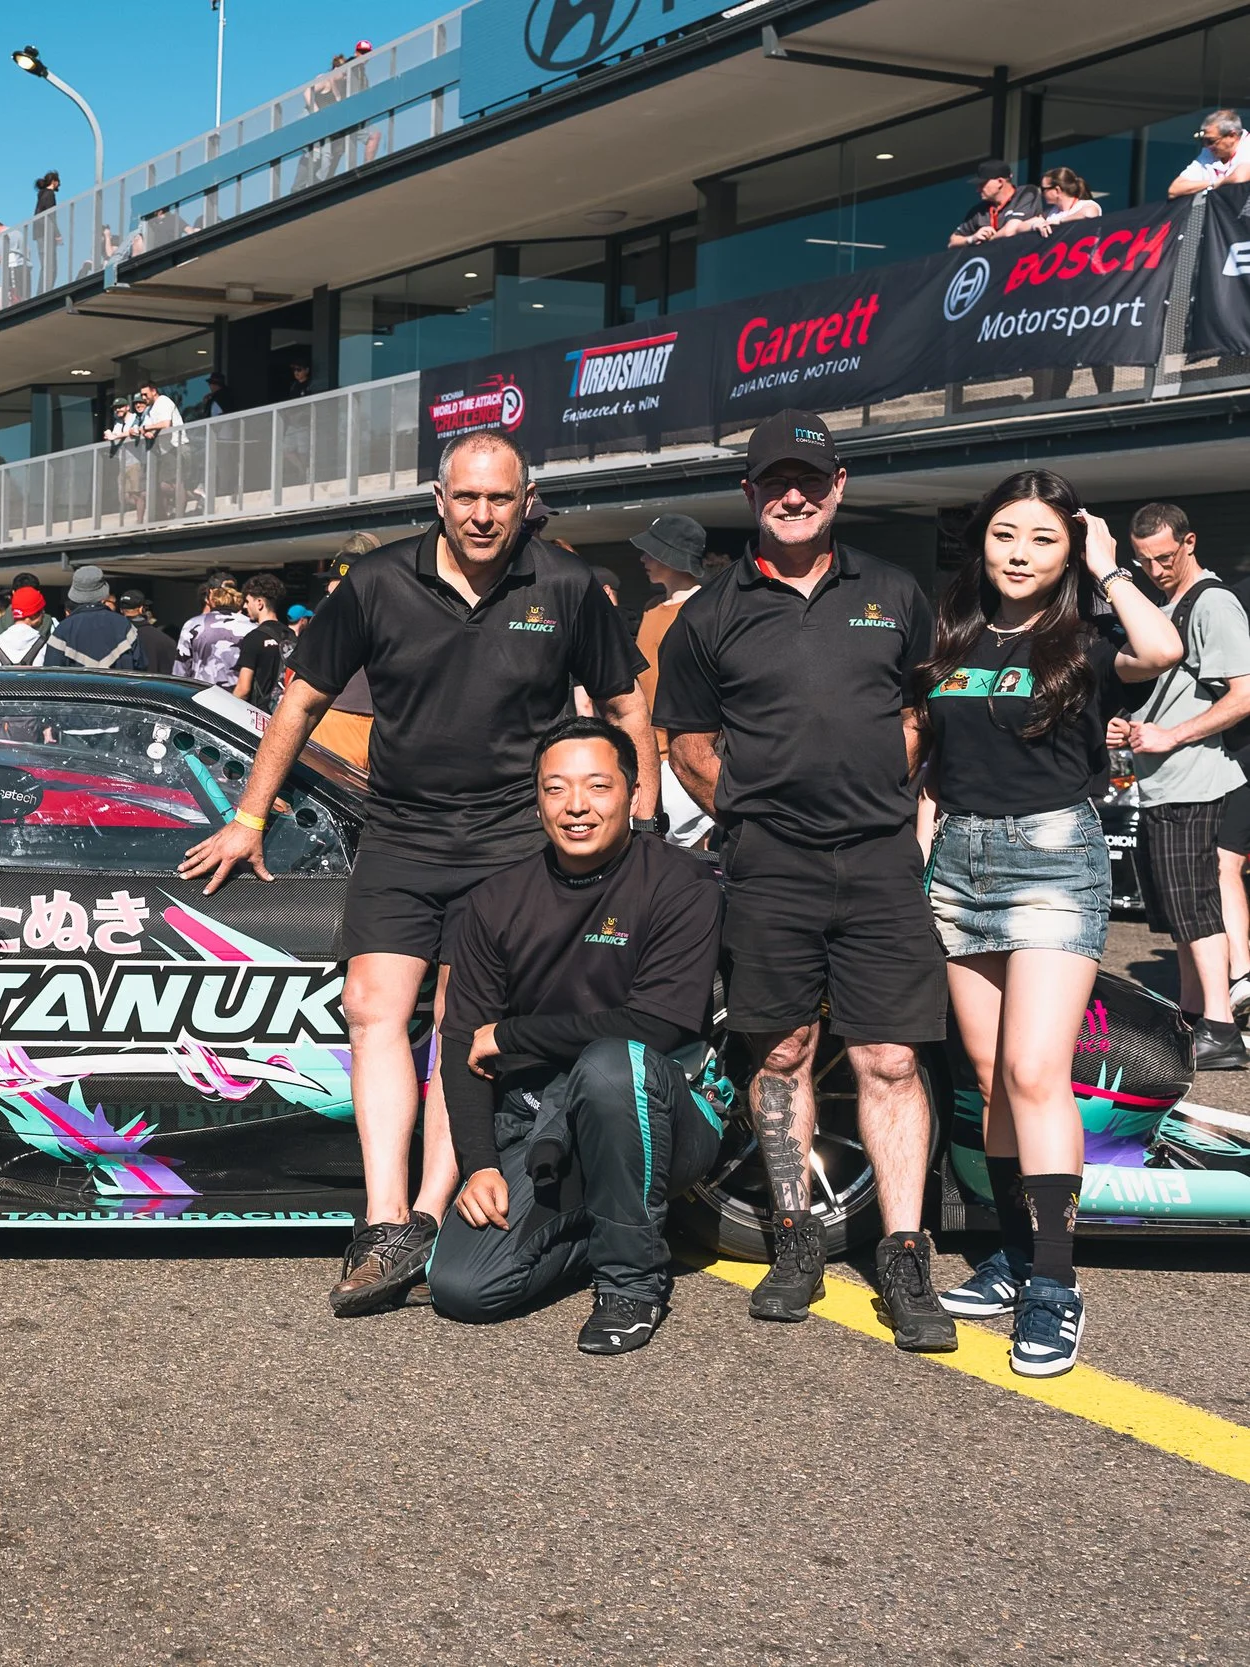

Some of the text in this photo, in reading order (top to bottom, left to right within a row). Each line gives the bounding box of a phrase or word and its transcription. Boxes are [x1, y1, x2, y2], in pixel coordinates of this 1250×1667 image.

[1004, 221, 1171, 294] BOSCH
[736, 294, 880, 373] Garrett
[977, 296, 1145, 343] Motorsport
[565, 331, 678, 397] TURBOSMART
[730, 356, 861, 399] ADVANCING MOTION
[433, 392, 503, 418] WORLD TIME ATTACK
[562, 395, 660, 427] Engineered to WIN
[435, 407, 502, 433] CHALLENGE
[795, 427, 825, 441] mmc
[508, 621, 556, 633] TANUKI
[848, 618, 897, 629] TANUKI
[584, 933, 629, 946] TANUKI
